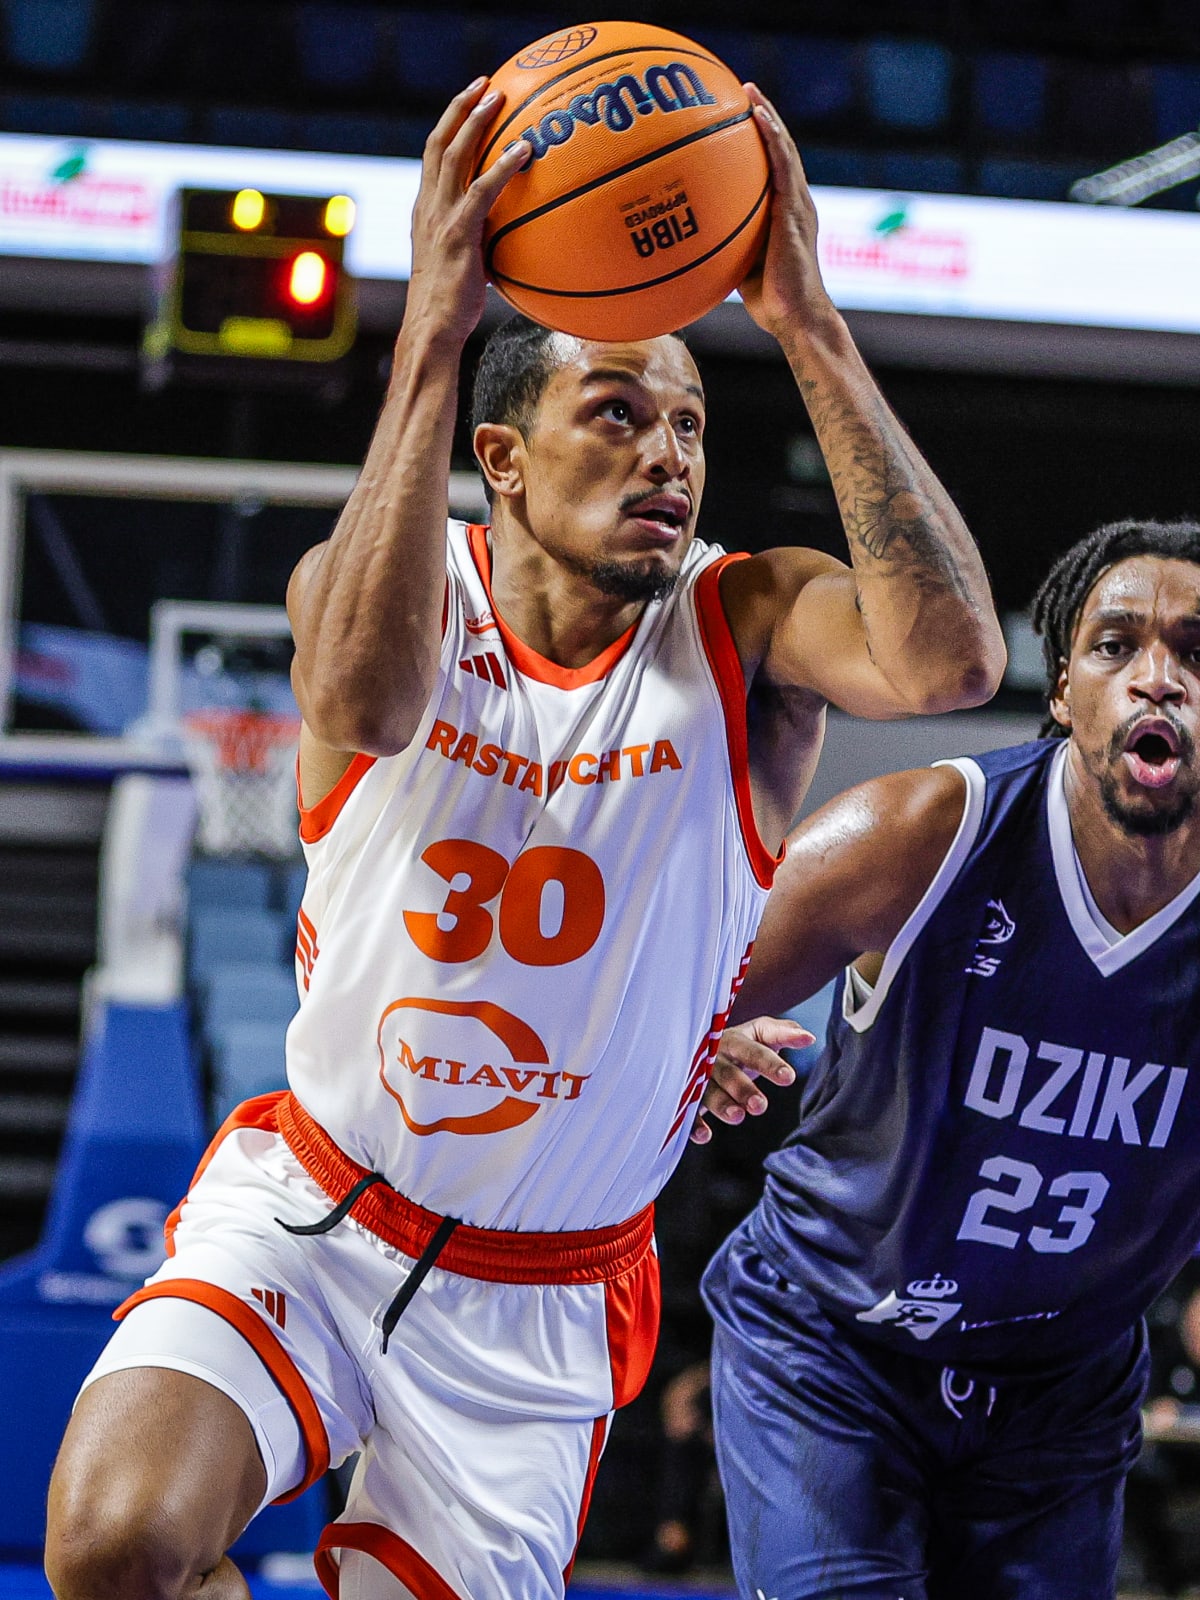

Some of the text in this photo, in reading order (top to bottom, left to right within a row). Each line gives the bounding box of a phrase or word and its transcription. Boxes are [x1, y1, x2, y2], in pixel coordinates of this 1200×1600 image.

[624, 191, 689, 229] APPROVED
[630, 207, 700, 258] FIBA
[425, 718, 543, 797] RASTA
[402, 838, 606, 968] 30
[396, 1037, 593, 1101] MIAVIT
[963, 1026, 1189, 1149] DZIKI
[956, 1155, 1111, 1254] 23
